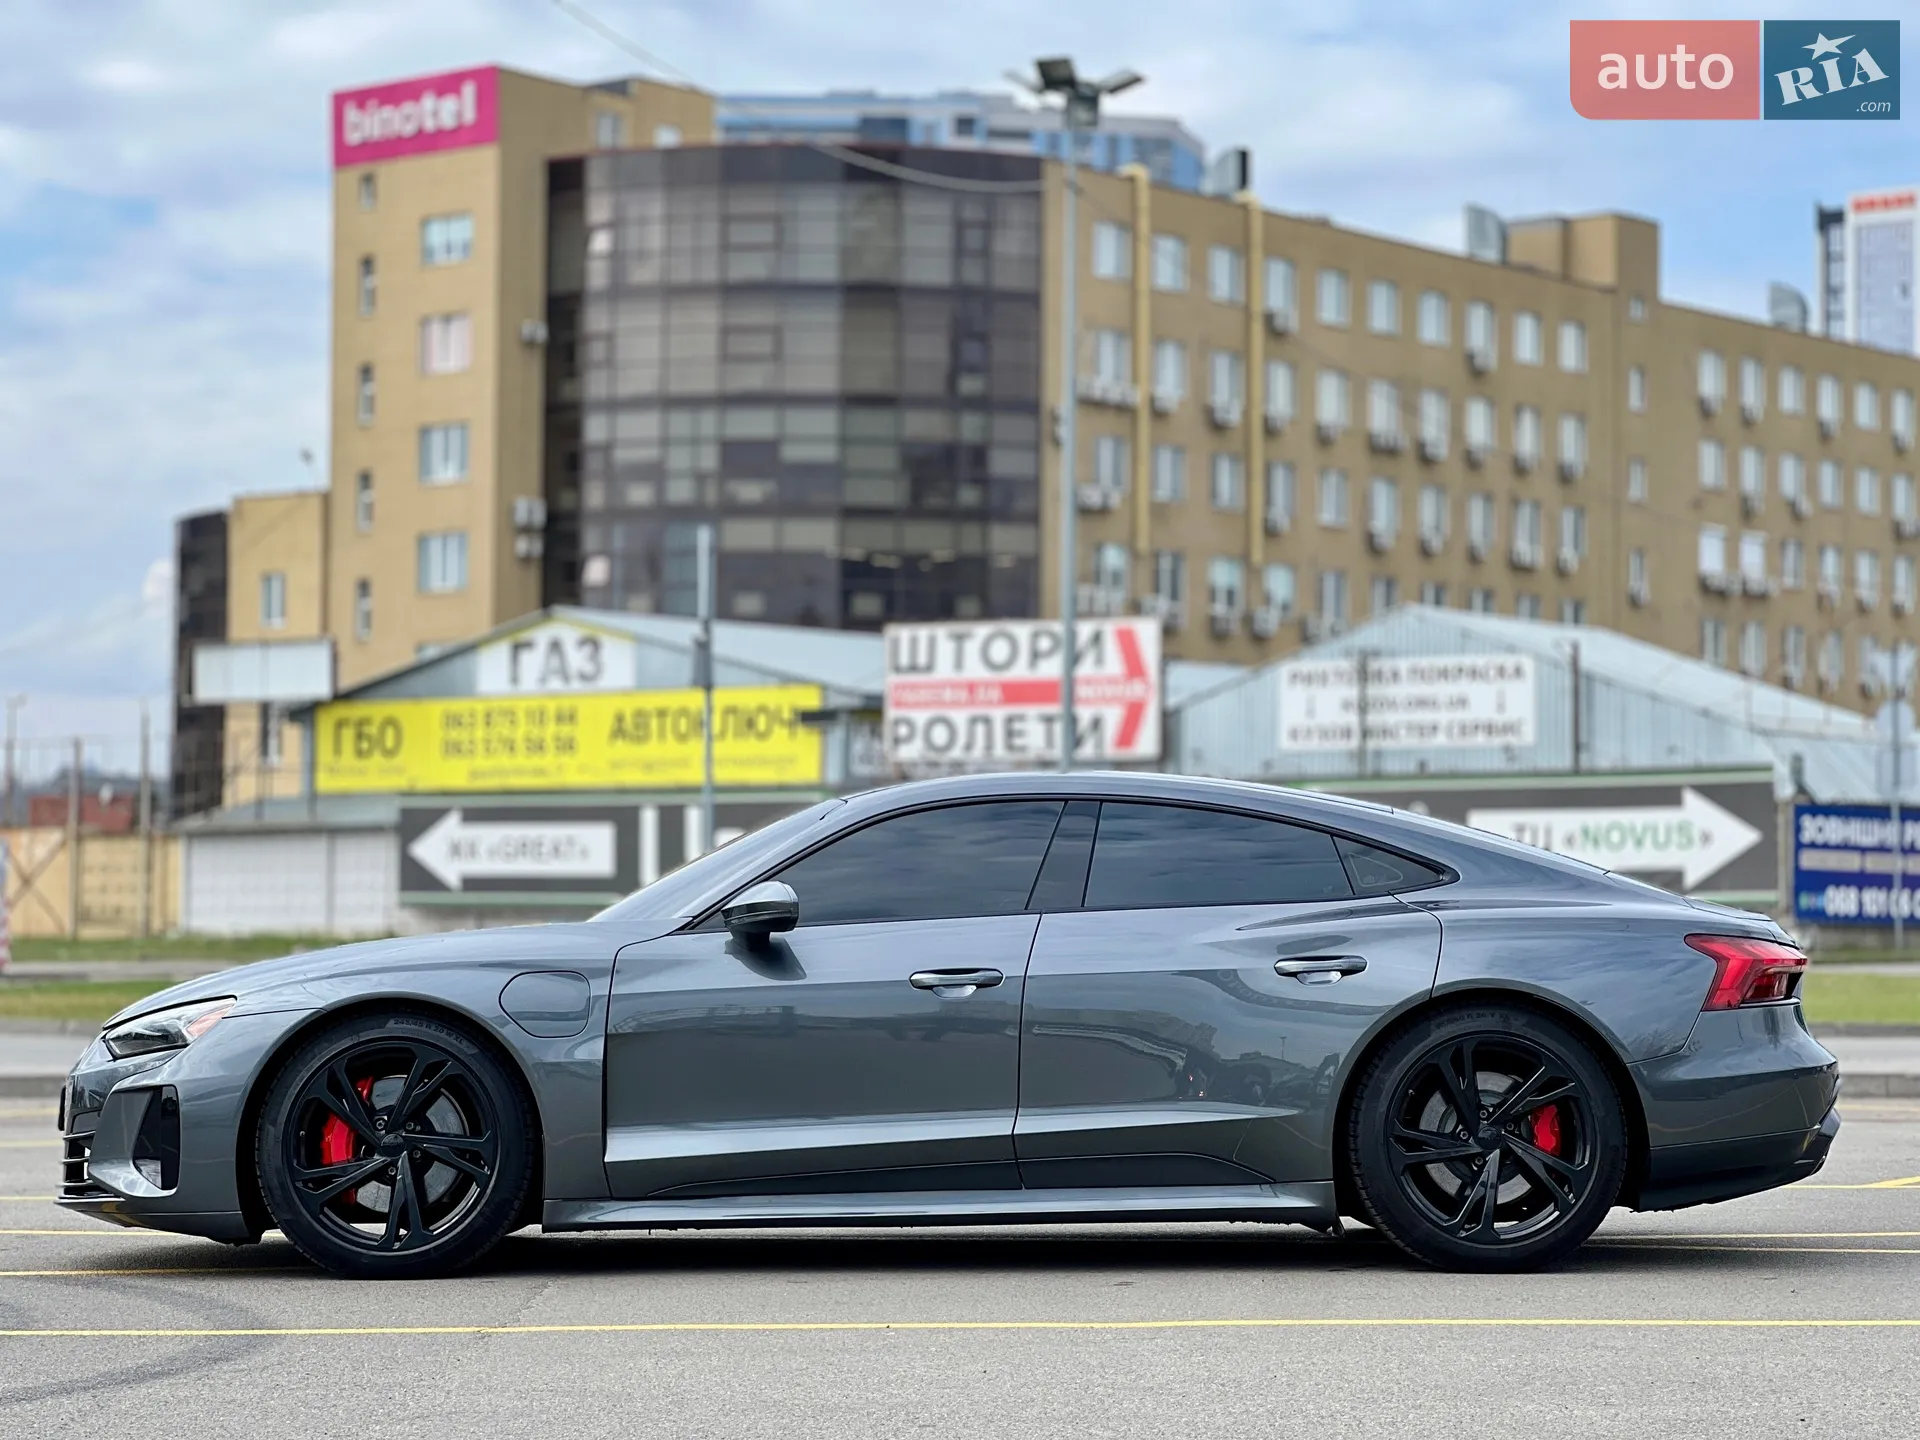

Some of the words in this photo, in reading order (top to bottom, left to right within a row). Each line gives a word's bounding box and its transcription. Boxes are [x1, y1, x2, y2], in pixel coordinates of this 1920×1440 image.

[343, 79, 478, 147] binotel
[508, 635, 604, 685] ГАЗ
[889, 628, 1105, 673] ШТОРИ
[332, 715, 404, 760] ГБО
[891, 713, 1105, 752] РОЛЕТИ
[1799, 813, 1902, 849] ЗОВНІШН
